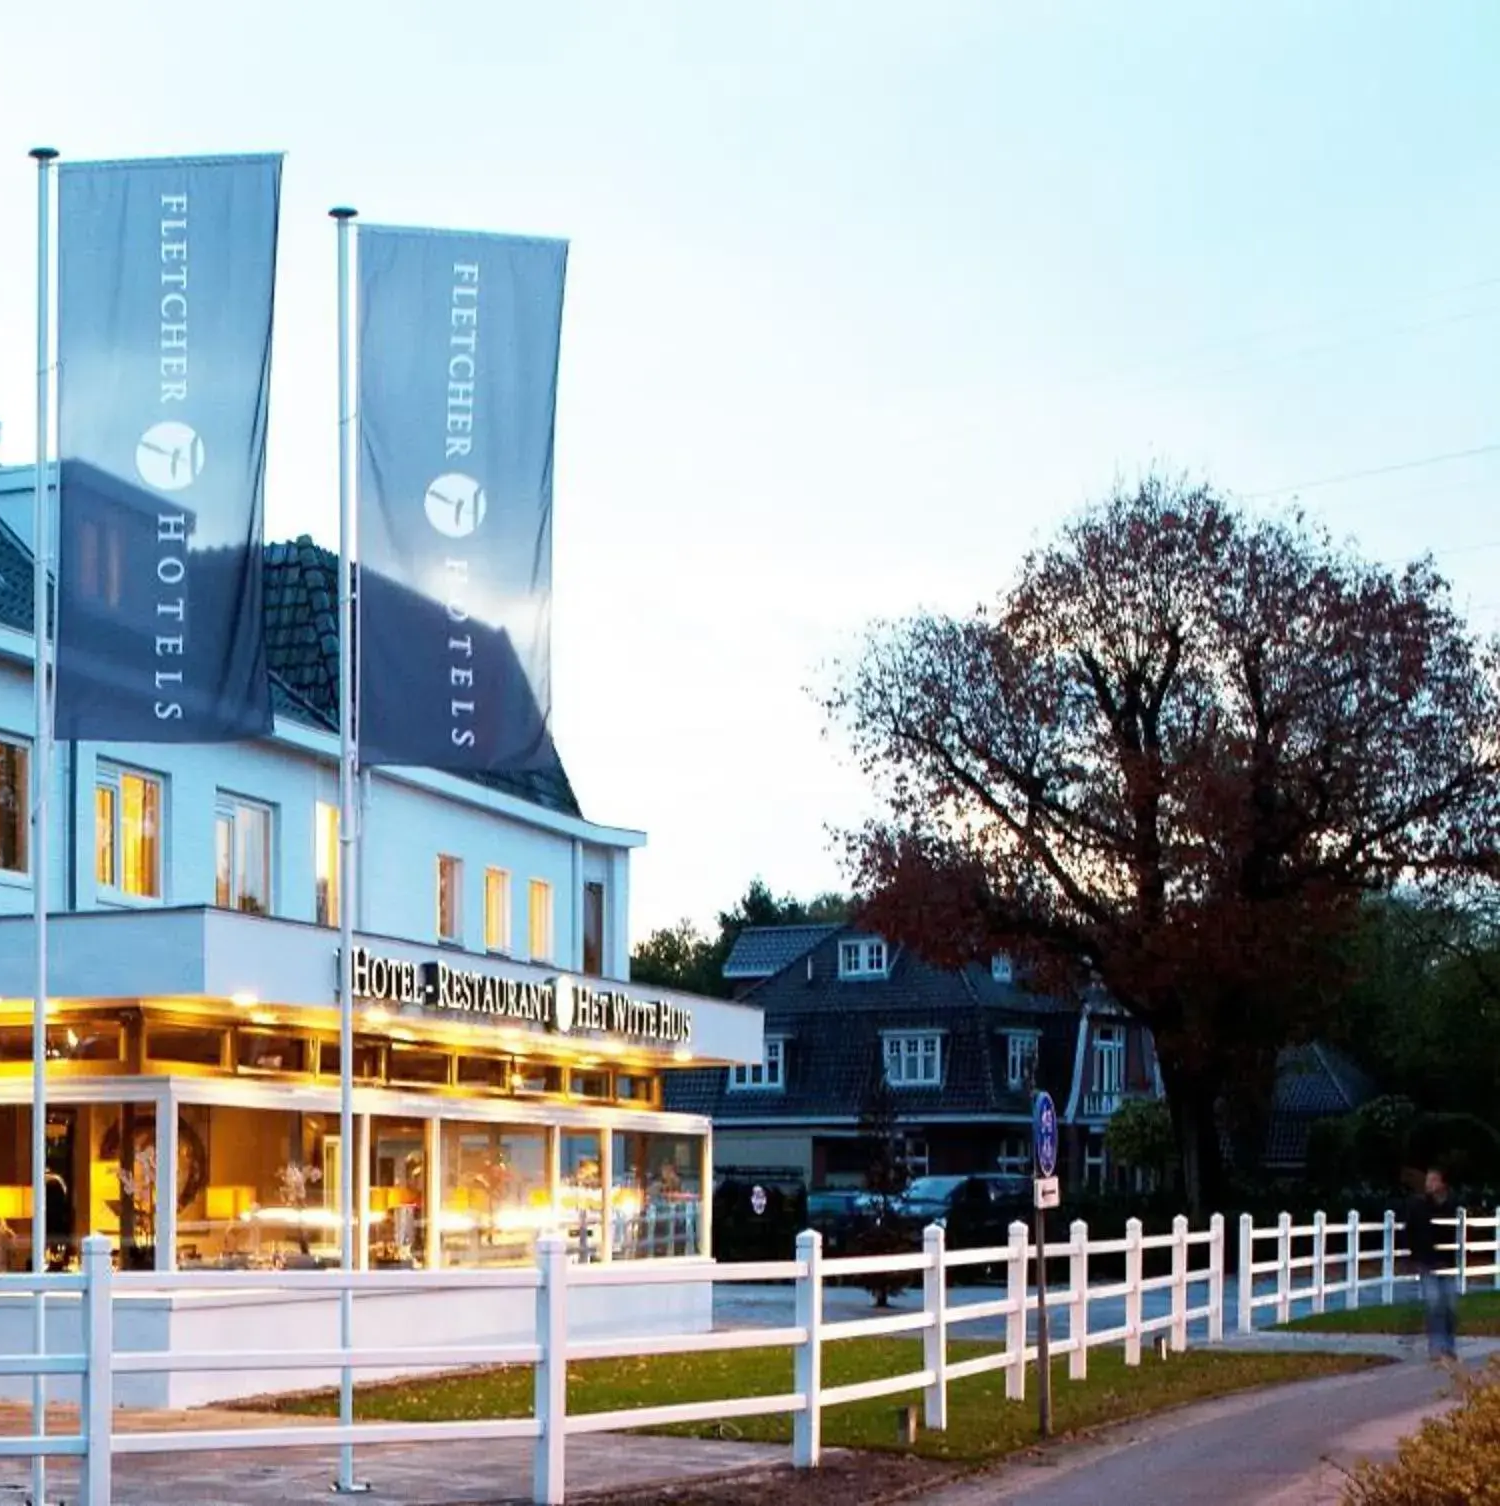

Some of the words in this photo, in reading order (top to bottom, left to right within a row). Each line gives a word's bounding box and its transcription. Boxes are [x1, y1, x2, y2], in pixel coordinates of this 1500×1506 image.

[160, 192, 188, 403] FLETCHER
[446, 262, 479, 459] FLETCHER
[155, 513, 186, 721] HOTELS
[352, 946, 424, 1003] HOTEL
[438, 960, 553, 1022] RESTAURANT
[577, 985, 609, 1032] HET
[611, 987, 658, 1038] WITTE
[659, 999, 692, 1044] HUIS
